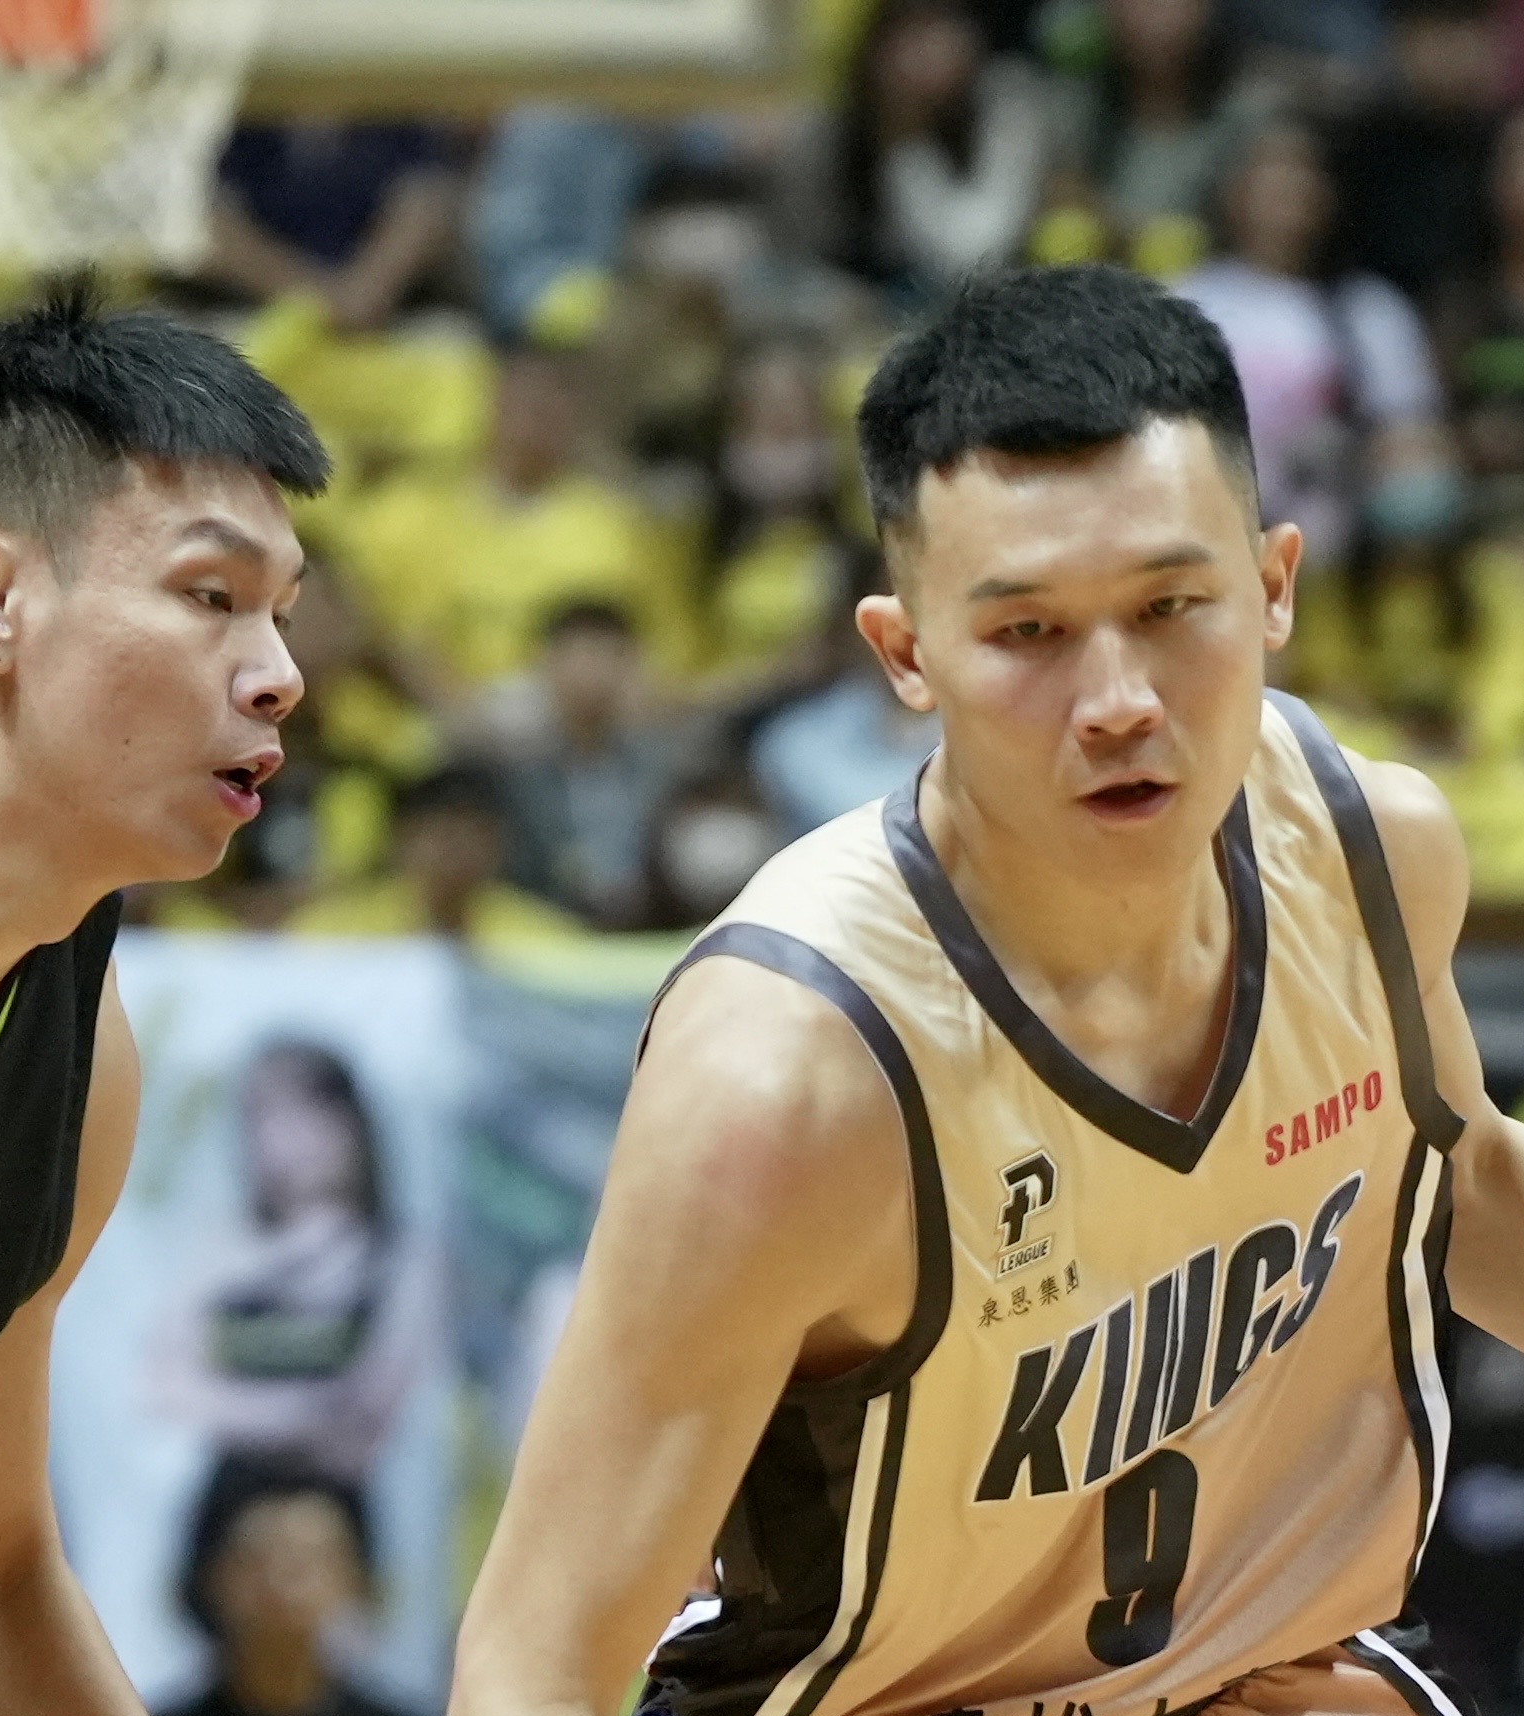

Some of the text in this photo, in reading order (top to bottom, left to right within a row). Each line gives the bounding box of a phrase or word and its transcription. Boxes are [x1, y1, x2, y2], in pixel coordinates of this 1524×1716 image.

[1264, 1069, 1382, 1167] SAMPO
[972, 1169, 1365, 1504] KINGS
[999, 1239, 1051, 1275] LEAGUE
[1085, 1447, 1199, 1668] 9
